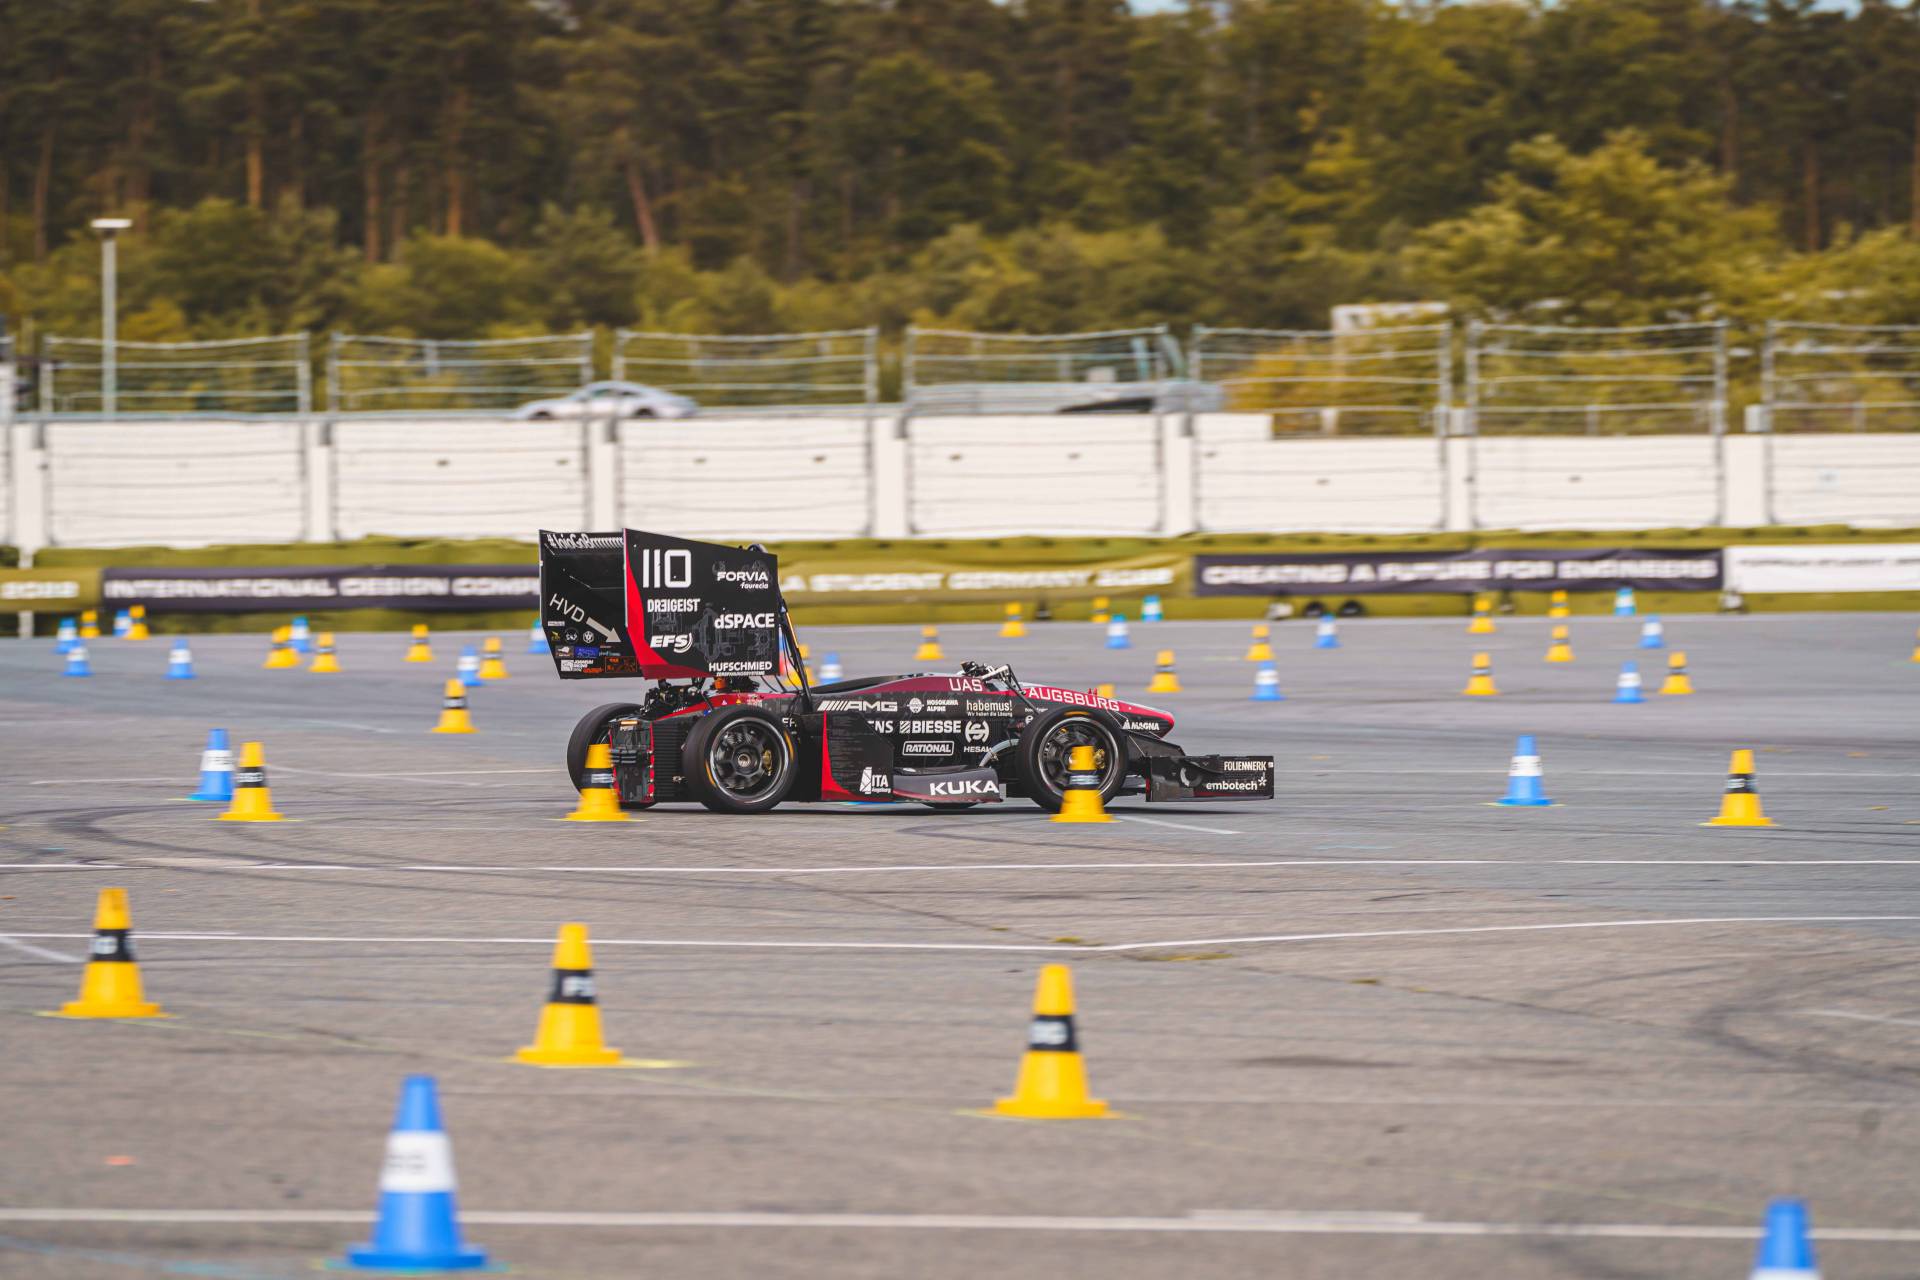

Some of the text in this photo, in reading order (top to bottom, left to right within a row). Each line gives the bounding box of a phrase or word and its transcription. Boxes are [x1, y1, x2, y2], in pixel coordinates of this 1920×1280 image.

[642, 549, 692, 588] 110
[1350, 563, 1375, 582] A
[1495, 560, 1554, 580] FOR
[717, 571, 769, 582] FORVIA
[105, 578, 336, 598] INTERNATIONAL
[549, 593, 586, 623] HVD
[714, 613, 775, 629] dSPACE
[650, 634, 691, 649] EFS
[708, 661, 772, 672] HUFSCHMIED
[949, 678, 1120, 712] UAS AUGSBURG
[847, 700, 898, 712] AMG
[966, 699, 1013, 711] habemus!
[912, 720, 961, 734] BIESSE
[1131, 721, 1160, 731] MAGNA
[905, 744, 952, 753] RATIONAL
[929, 780, 999, 796] KUKA
[1206, 780, 1258, 790] embotech
